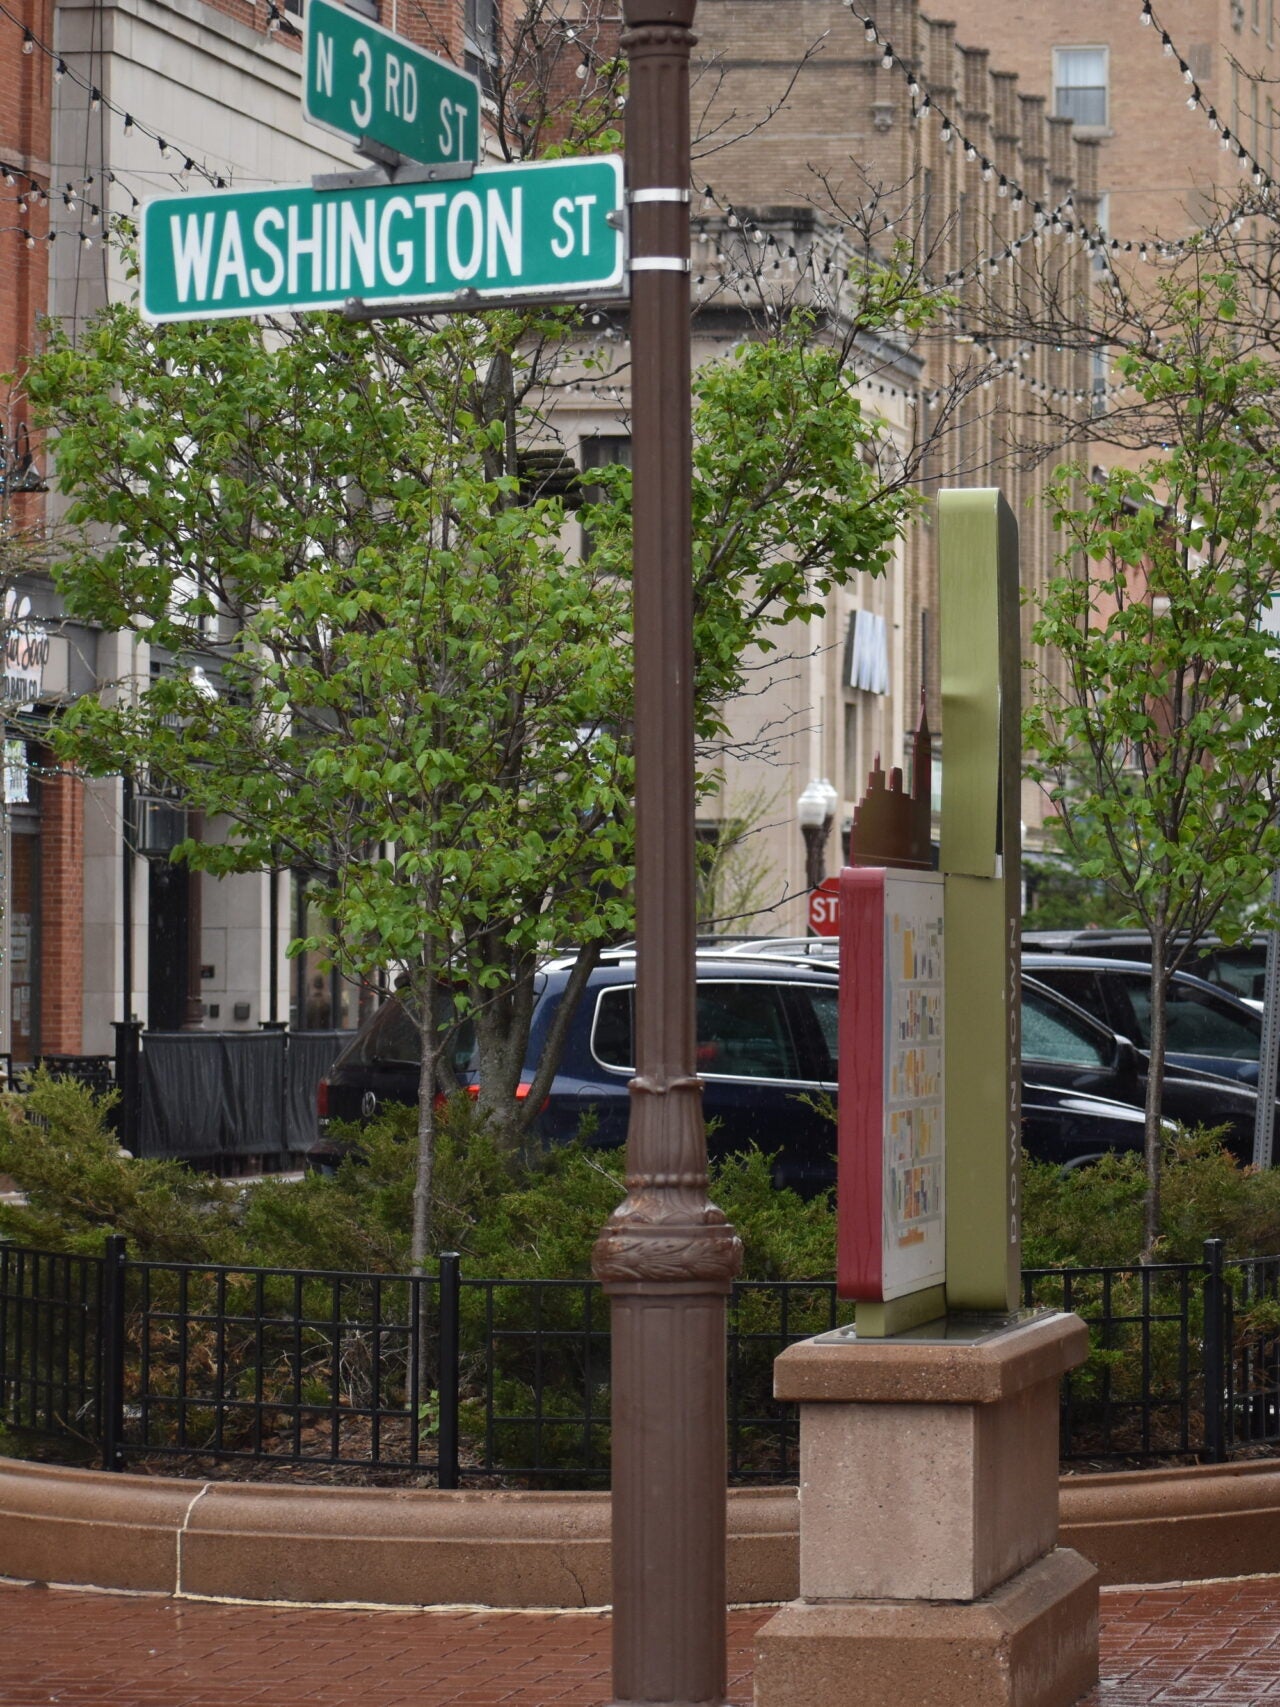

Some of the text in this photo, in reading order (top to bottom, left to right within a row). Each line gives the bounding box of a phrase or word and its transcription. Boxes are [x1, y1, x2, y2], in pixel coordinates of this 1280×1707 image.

[316, 32, 469, 162] N 3RD ST
[169, 186, 597, 303] WASHINGTON ST
[812, 896, 840, 923] ST
[1009, 917, 1018, 1244] DOWNTOWN
